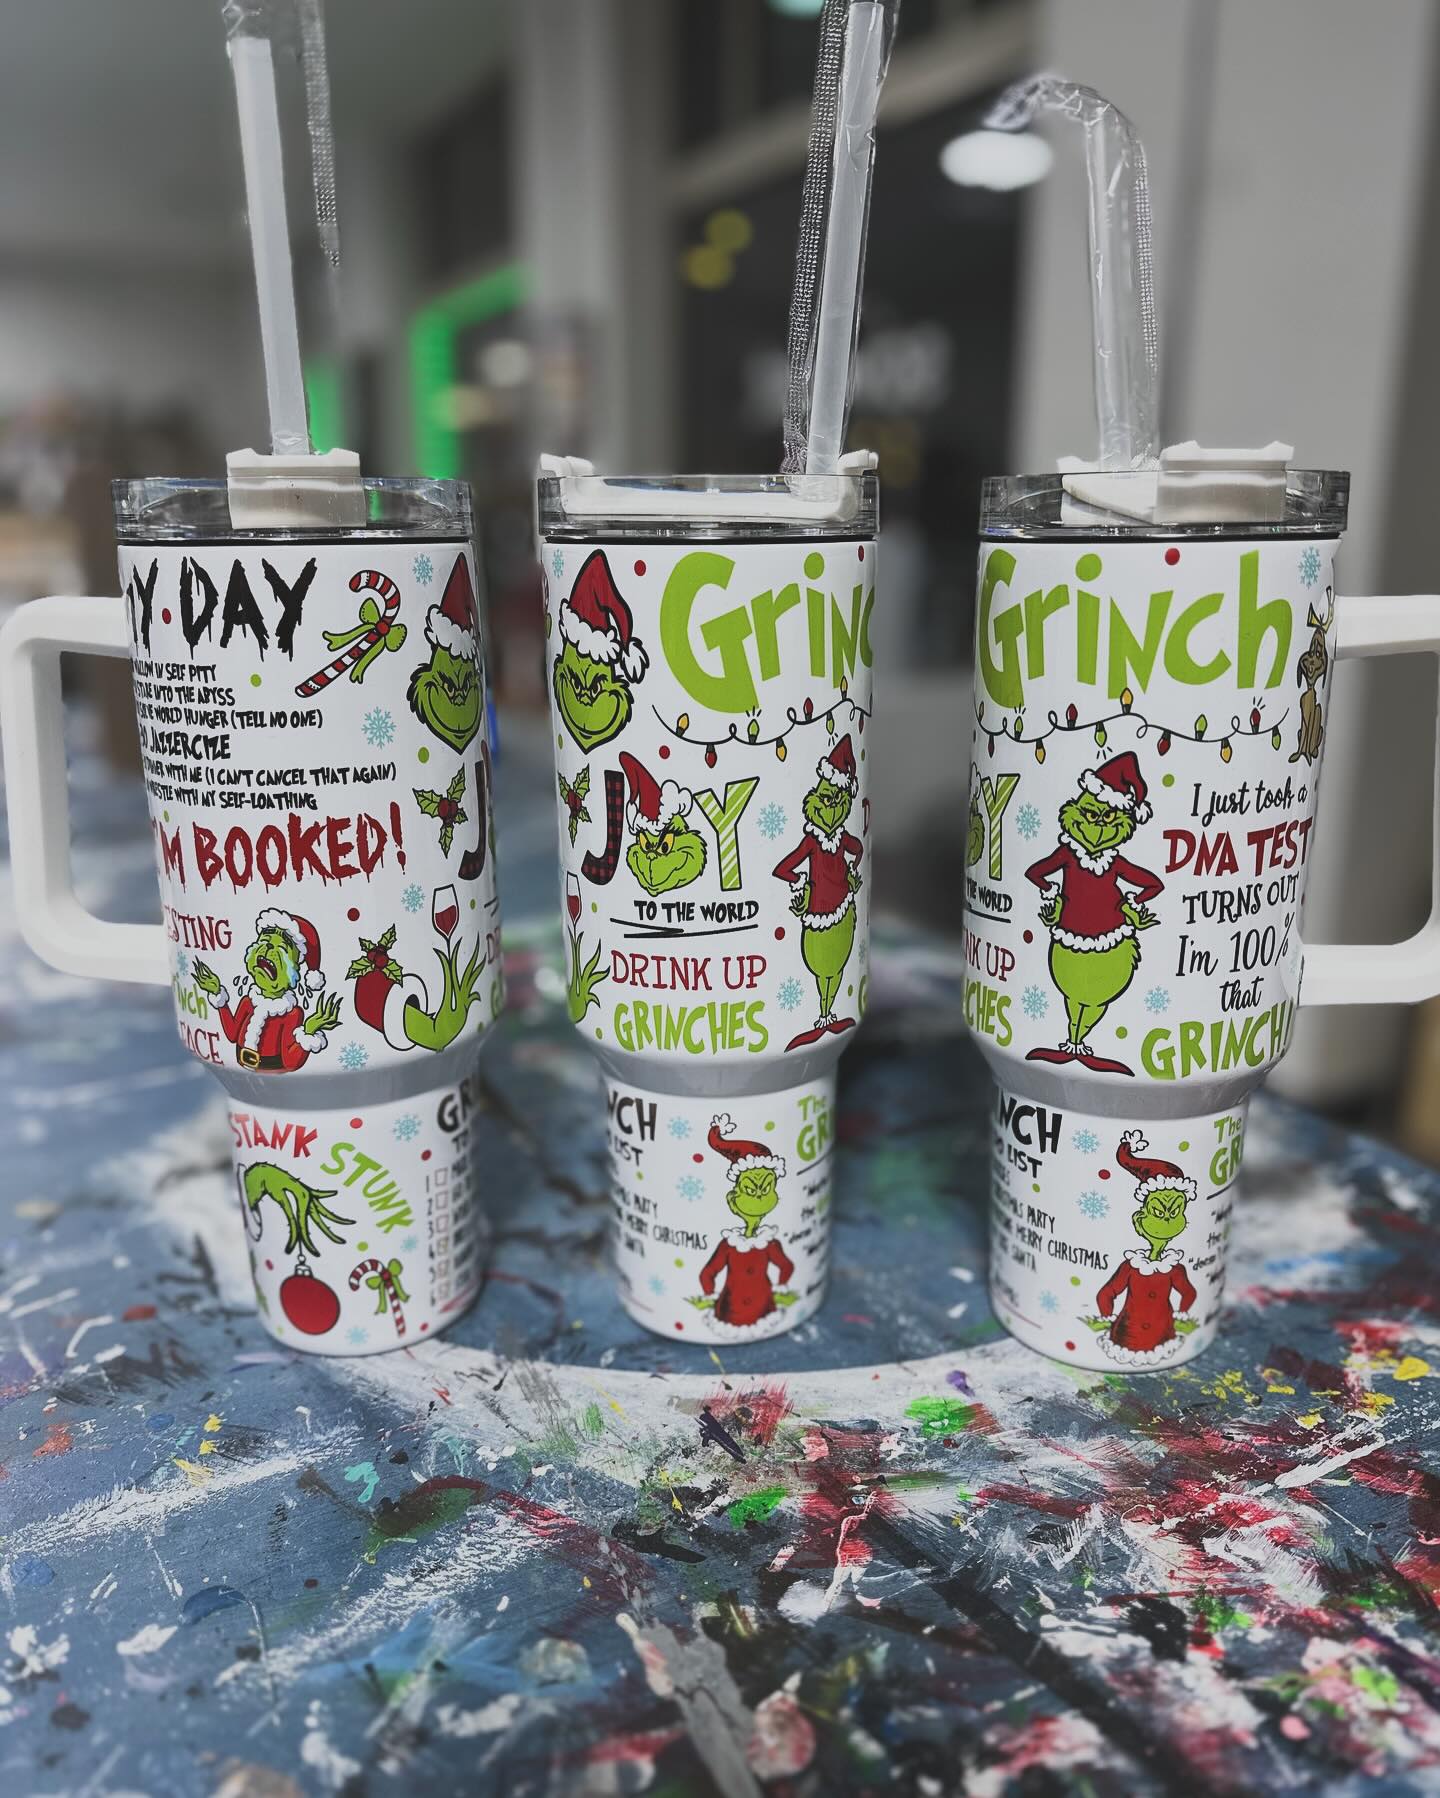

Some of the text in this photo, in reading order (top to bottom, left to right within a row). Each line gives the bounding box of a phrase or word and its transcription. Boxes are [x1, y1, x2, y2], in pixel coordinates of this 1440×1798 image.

[180, 556, 317, 661] DAY
[165, 662, 186, 682] SELF
[188, 664, 216, 684] PITY
[175, 685, 195, 704] THE
[198, 687, 235, 707] ABYSS
[154, 705, 182, 724] WORLD
[184, 708, 229, 729] HUNGER
[231, 709, 267, 730] (TELL
[270, 711, 287, 729] NO
[290, 708, 323, 729] ONE)
[151, 727, 231, 760] JAZZERCIZE
[165, 763, 188, 783] WITH
[190, 766, 203, 783] ME
[217, 768, 254, 788] CAN'T
[256, 768, 307, 787] CANCEL
[310, 767, 350, 787] THAT
[353, 761, 397, 784] AGAIN)
[174, 786, 199, 806] WITH
[202, 790, 216, 808] MY
[219, 791, 318, 810] SELF-LOATHING
[1191, 775, 1308, 828] I just took a
[193, 801, 407, 895] BOOKED!
[1163, 815, 1313, 877] DNA TEST
[633, 900, 759, 923] TO THE WORLD
[978, 886, 1013, 912] WORLD
[1182, 871, 1300, 924] TURNS OUT
[986, 942, 1016, 982] UP
[1176, 911, 1295, 977] I'm 100%
[611, 949, 767, 991] DRINK UP
[1219, 976, 1265, 1013] that
[614, 1000, 769, 1055] GRINCHES
[1141, 996, 1293, 1081] GRINCH!
[228, 1112, 318, 1158] STANK
[1213, 1115, 1242, 1144] The
[1008, 1143, 1043, 1179] LIST
[320, 1142, 414, 1233] STUNK
[653, 1225, 708, 1250] CHRISTMAS
[1027, 1205, 1056, 1234] PARTY
[1048, 1239, 1109, 1271] CHRISTMAS
